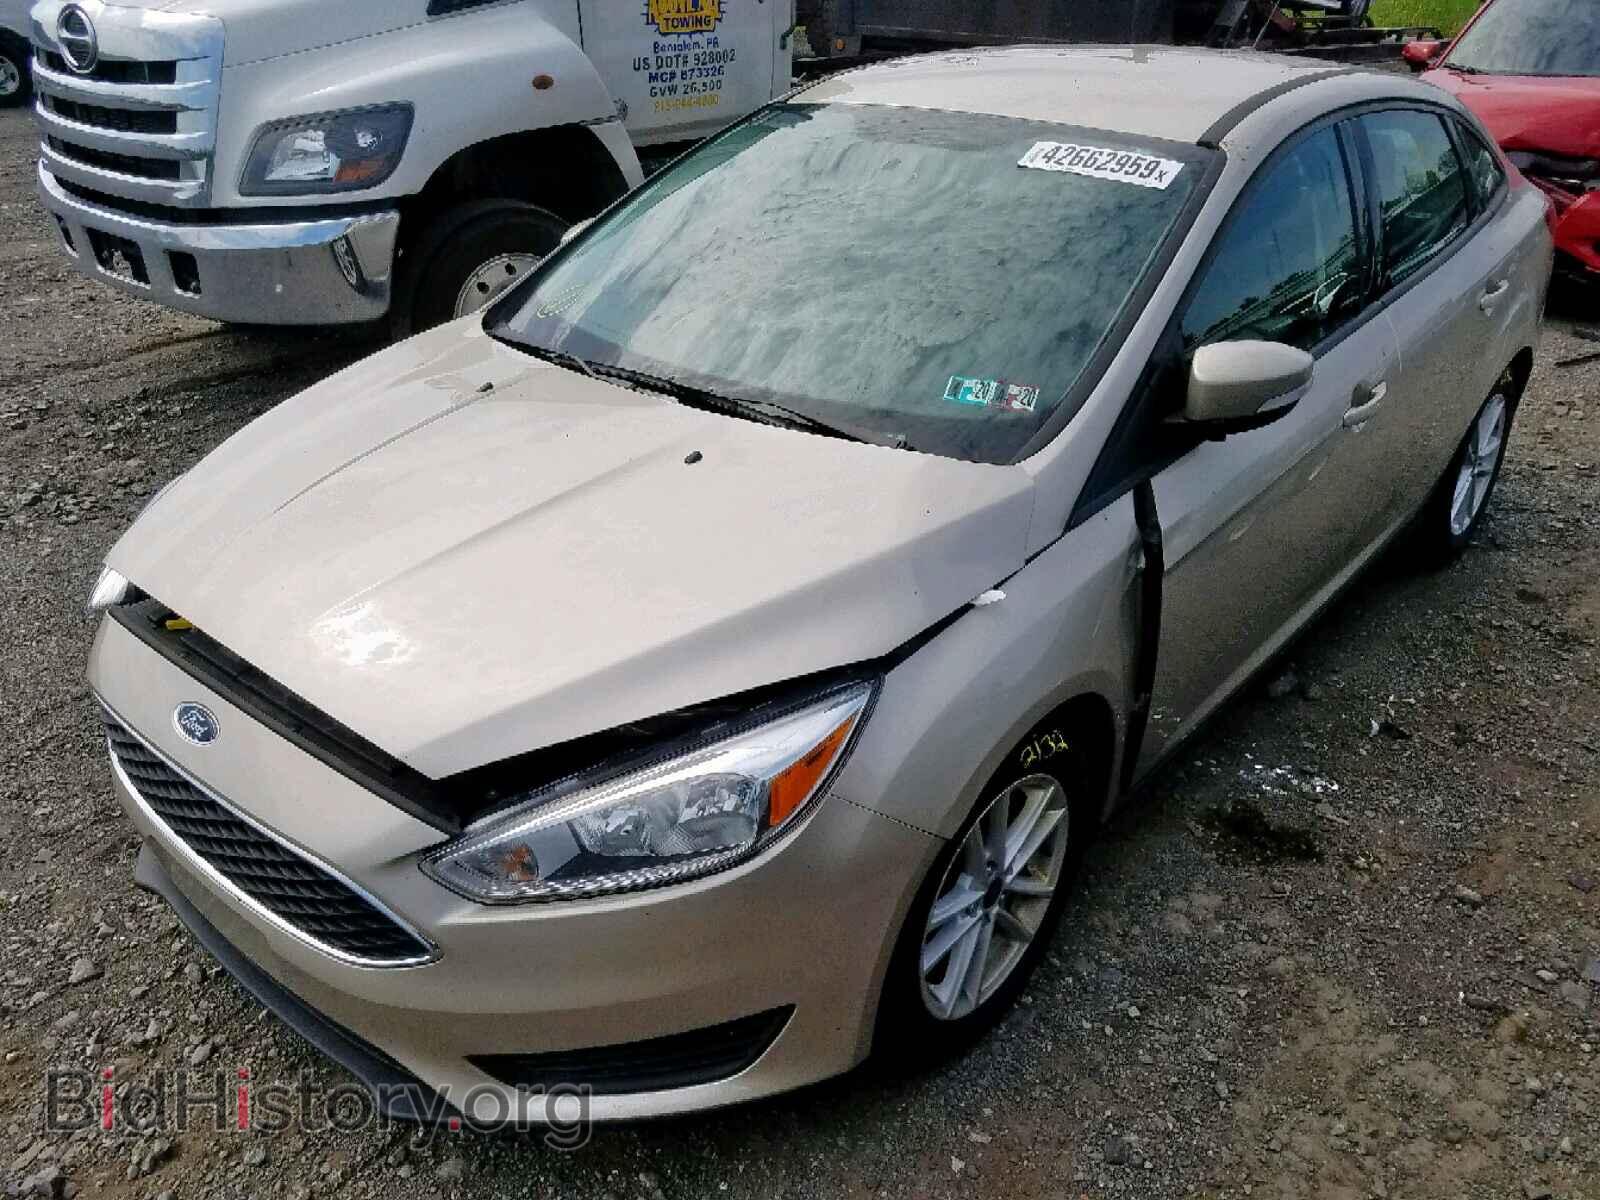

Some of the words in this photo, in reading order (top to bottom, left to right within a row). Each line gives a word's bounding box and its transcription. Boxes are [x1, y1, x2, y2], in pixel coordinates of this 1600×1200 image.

[664, 15, 711, 30] TOWING
[707, 37, 719, 49] PA
[633, 57, 650, 72] US
[656, 54, 689, 70] DOT#
[693, 49, 736, 68] 928002
[649, 71, 677, 84] MC#
[650, 84, 678, 98] GVW
